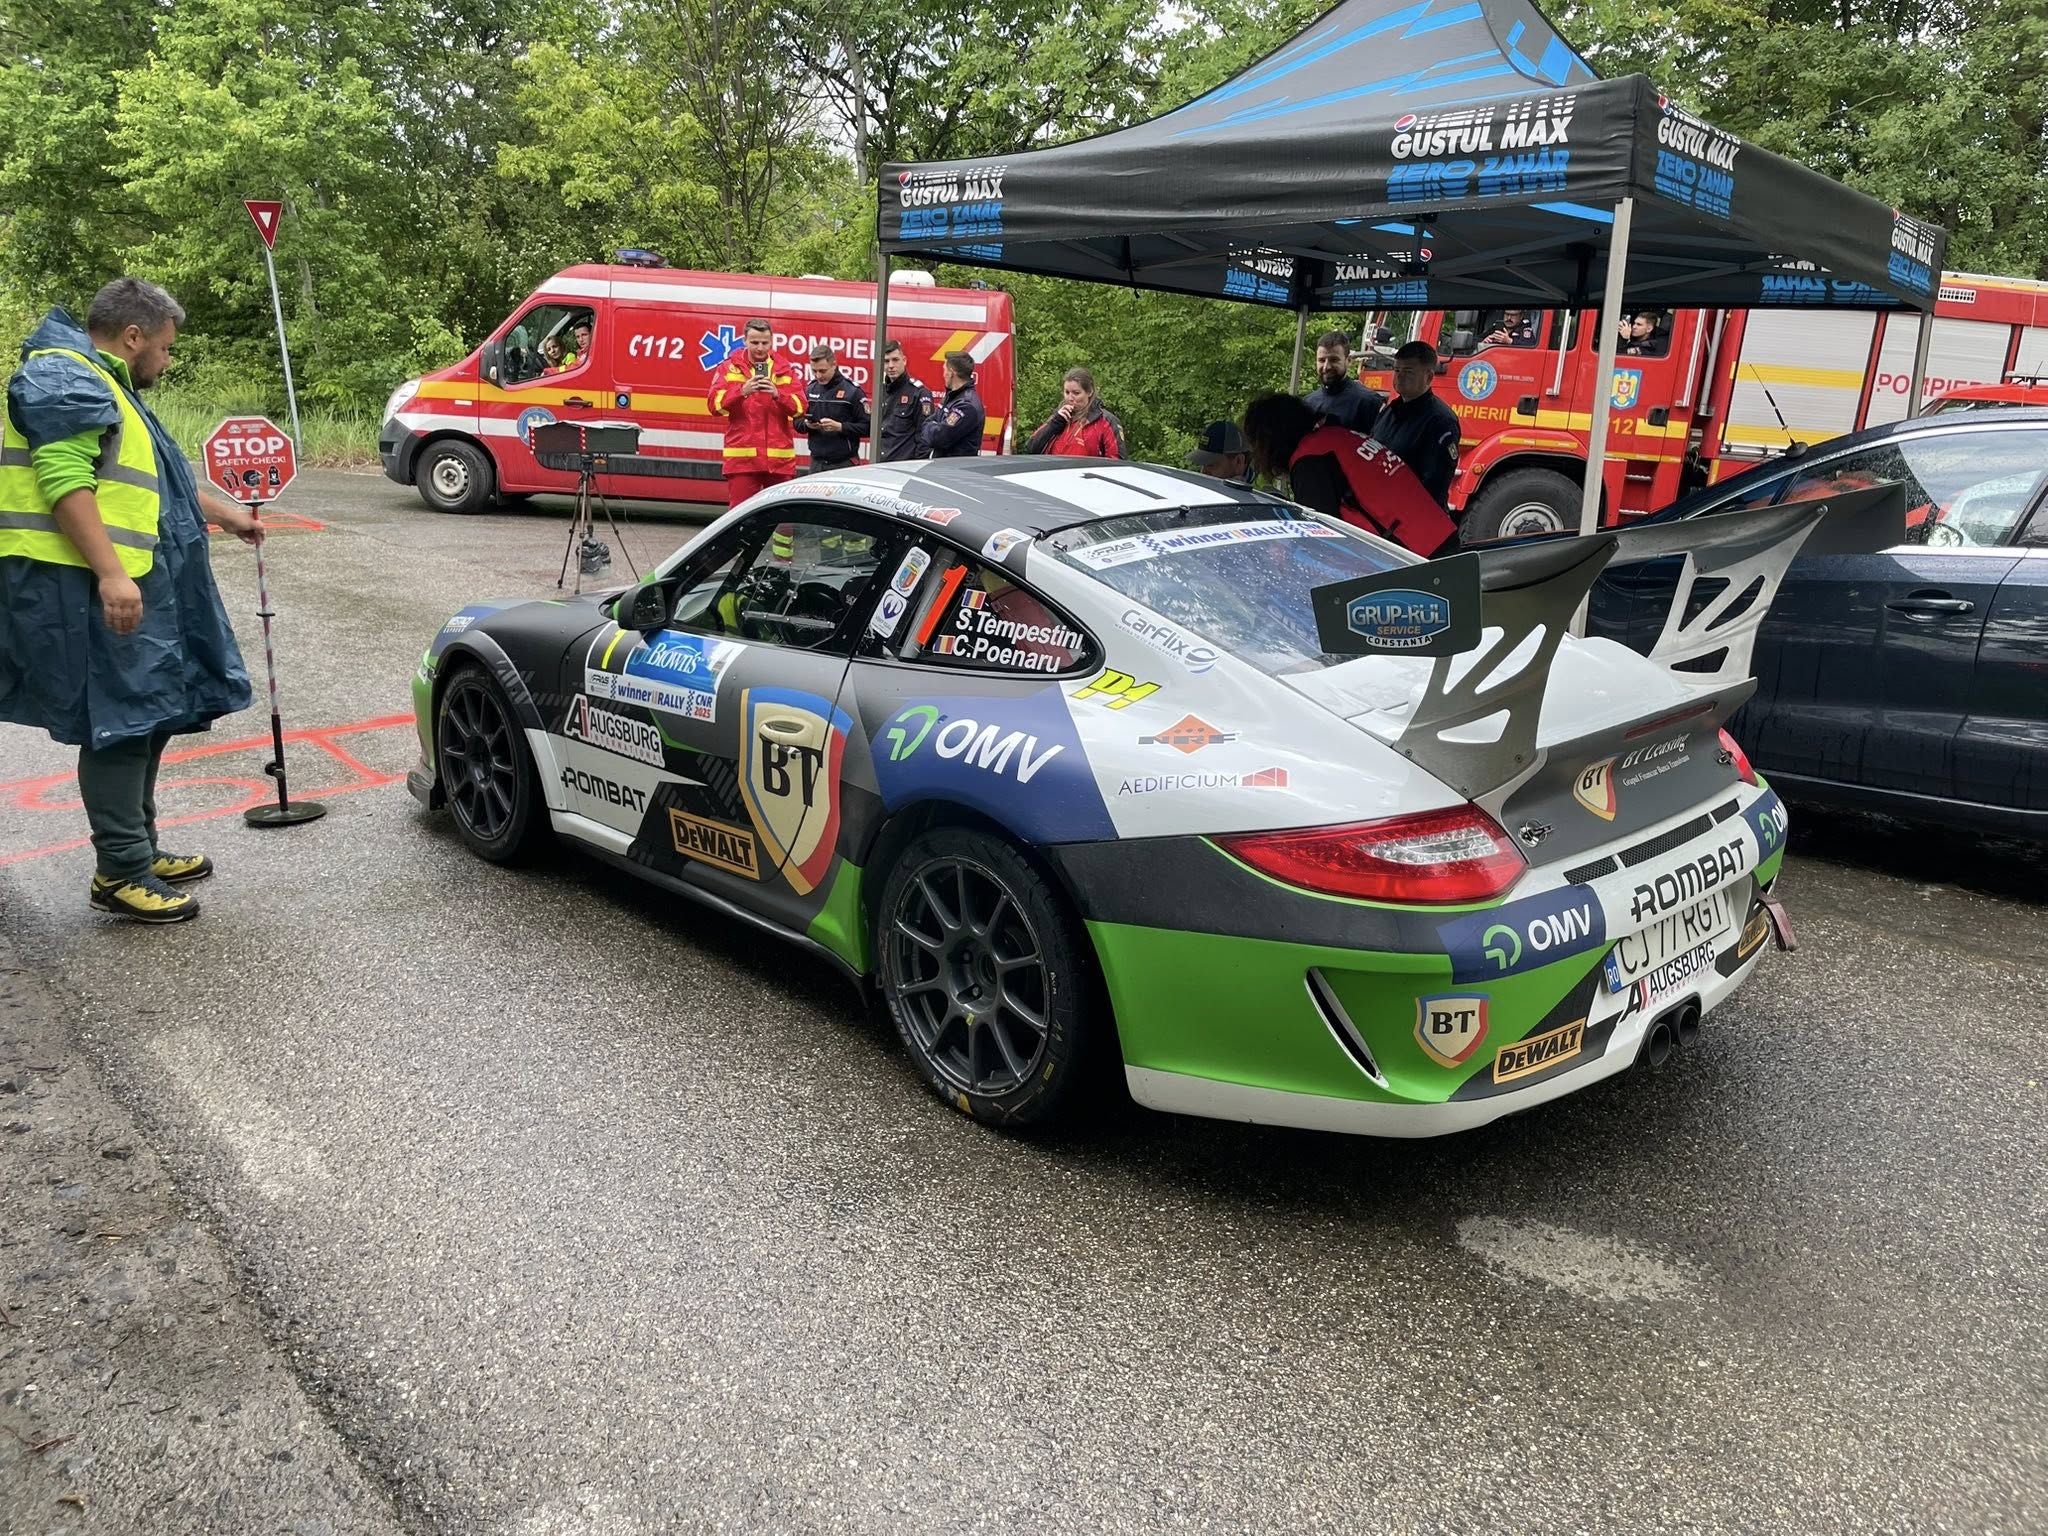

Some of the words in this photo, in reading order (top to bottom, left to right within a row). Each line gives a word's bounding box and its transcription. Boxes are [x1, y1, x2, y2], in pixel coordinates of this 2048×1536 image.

[1391, 124, 1493, 159] GUSTUL
[1500, 115, 1574, 149] MAX
[1657, 116, 1709, 159] GUSTUL
[1706, 136, 1740, 171] MAX
[1387, 160, 1476, 190] ZERO
[1655, 149, 1697, 190] ZERO
[900, 183, 960, 207] GUSTUL
[962, 177, 1003, 201] MAX
[900, 207, 949, 231] ZERO
[1891, 227, 1917, 258] GUSTUL
[1917, 241, 1934, 267] MAX
[641, 335, 685, 359] 112
[213, 436, 284, 458] STOP
[215, 457, 250, 467] SAFETY
[252, 456, 286, 465] CHECK!
[863, 493, 928, 518] AEDIFICIUM
[1163, 532, 1232, 549] winner
[1241, 524, 1289, 541] RALLY
[916, 564, 969, 646] 1
[956, 607, 1084, 650] S.Tempestini
[1121, 609, 1190, 656] CarFlix
[1377, 626, 1421, 636] SERVICE
[647, 642, 701, 674] Brown's
[953, 634, 1061, 673] C.Poenaru
[618, 682, 652, 702] winner
[657, 693, 686, 711] RALLY
[694, 706, 711, 718] 2025
[695, 693, 712, 708] CNR
[590, 710, 660, 753] AUGSBURG
[935, 719, 1066, 784] OMV
[1620, 747, 1649, 770] BT
[1643, 732, 1691, 762] Leasing
[762, 736, 824, 807] BT
[1118, 774, 1238, 796] AEDIFICIUM
[1582, 763, 1609, 790] BT
[561, 767, 646, 814] ROMBAT
[1631, 837, 1744, 924] ROMBAT
[1527, 903, 1591, 951] OMV
[1618, 929, 1650, 974] CJ
[1607, 965, 1620, 985] RO
[1650, 940, 1715, 999] AUGSBURG
[1431, 1009, 1475, 1035] BT
